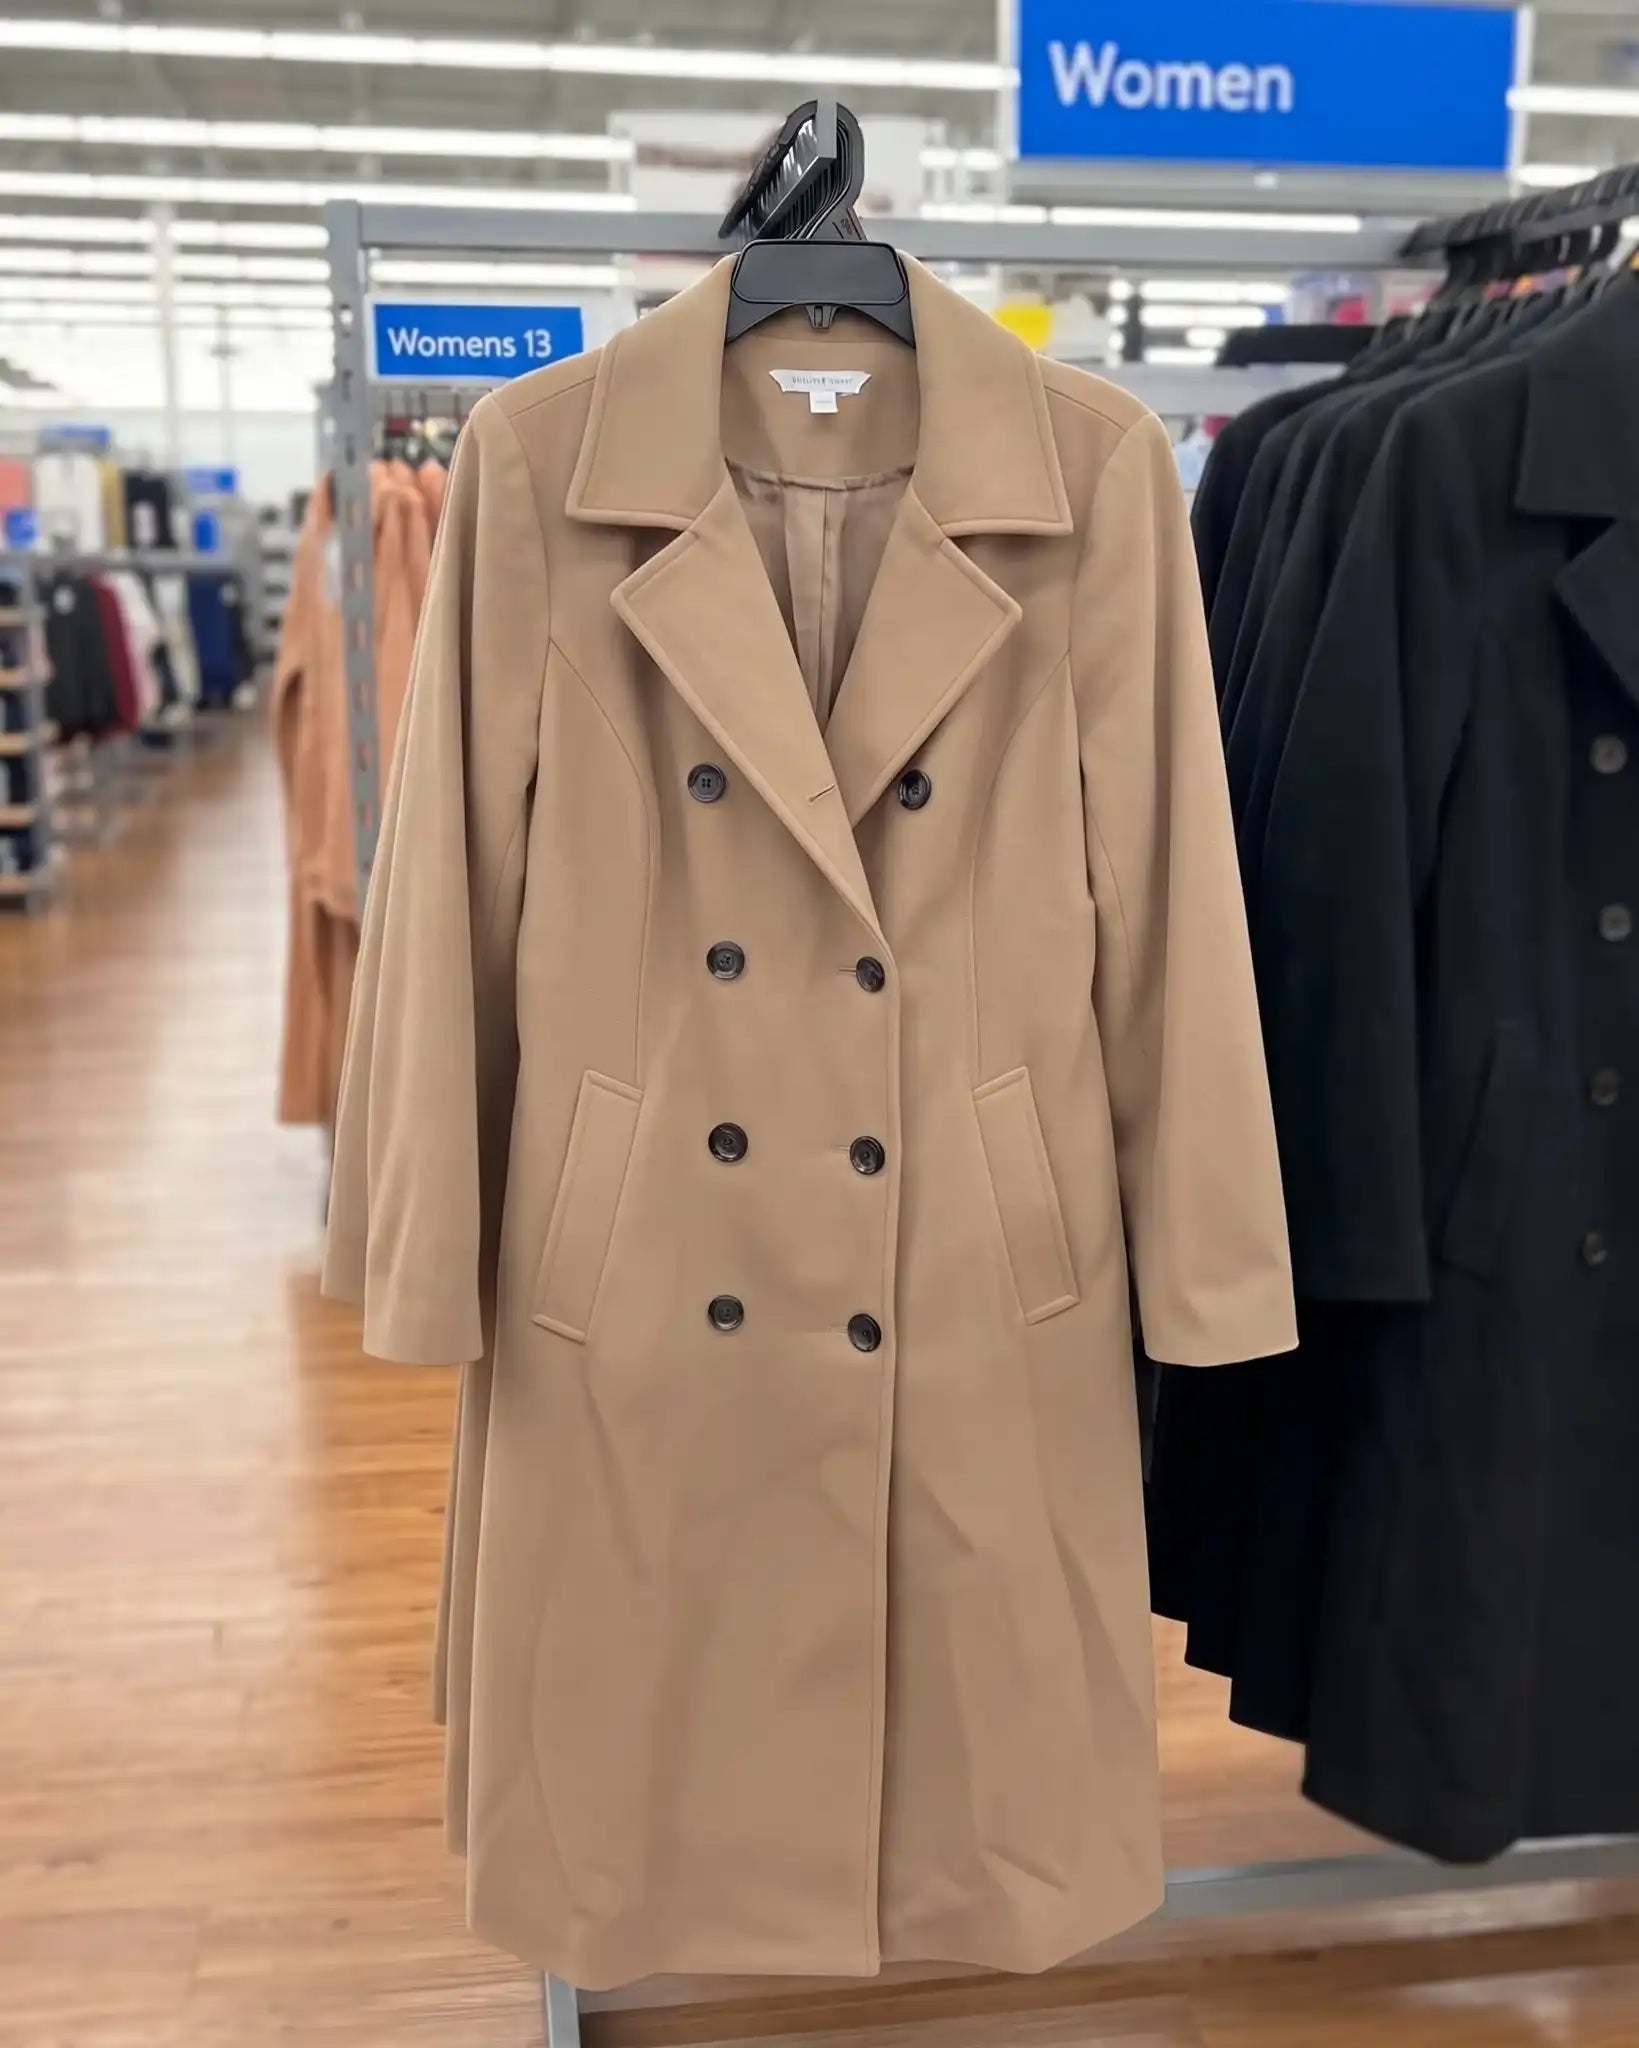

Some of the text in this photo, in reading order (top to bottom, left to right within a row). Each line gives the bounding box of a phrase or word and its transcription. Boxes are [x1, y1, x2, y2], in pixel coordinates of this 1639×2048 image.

[1048, 40, 1294, 113] Women
[387, 327, 552, 359] Womens 13
